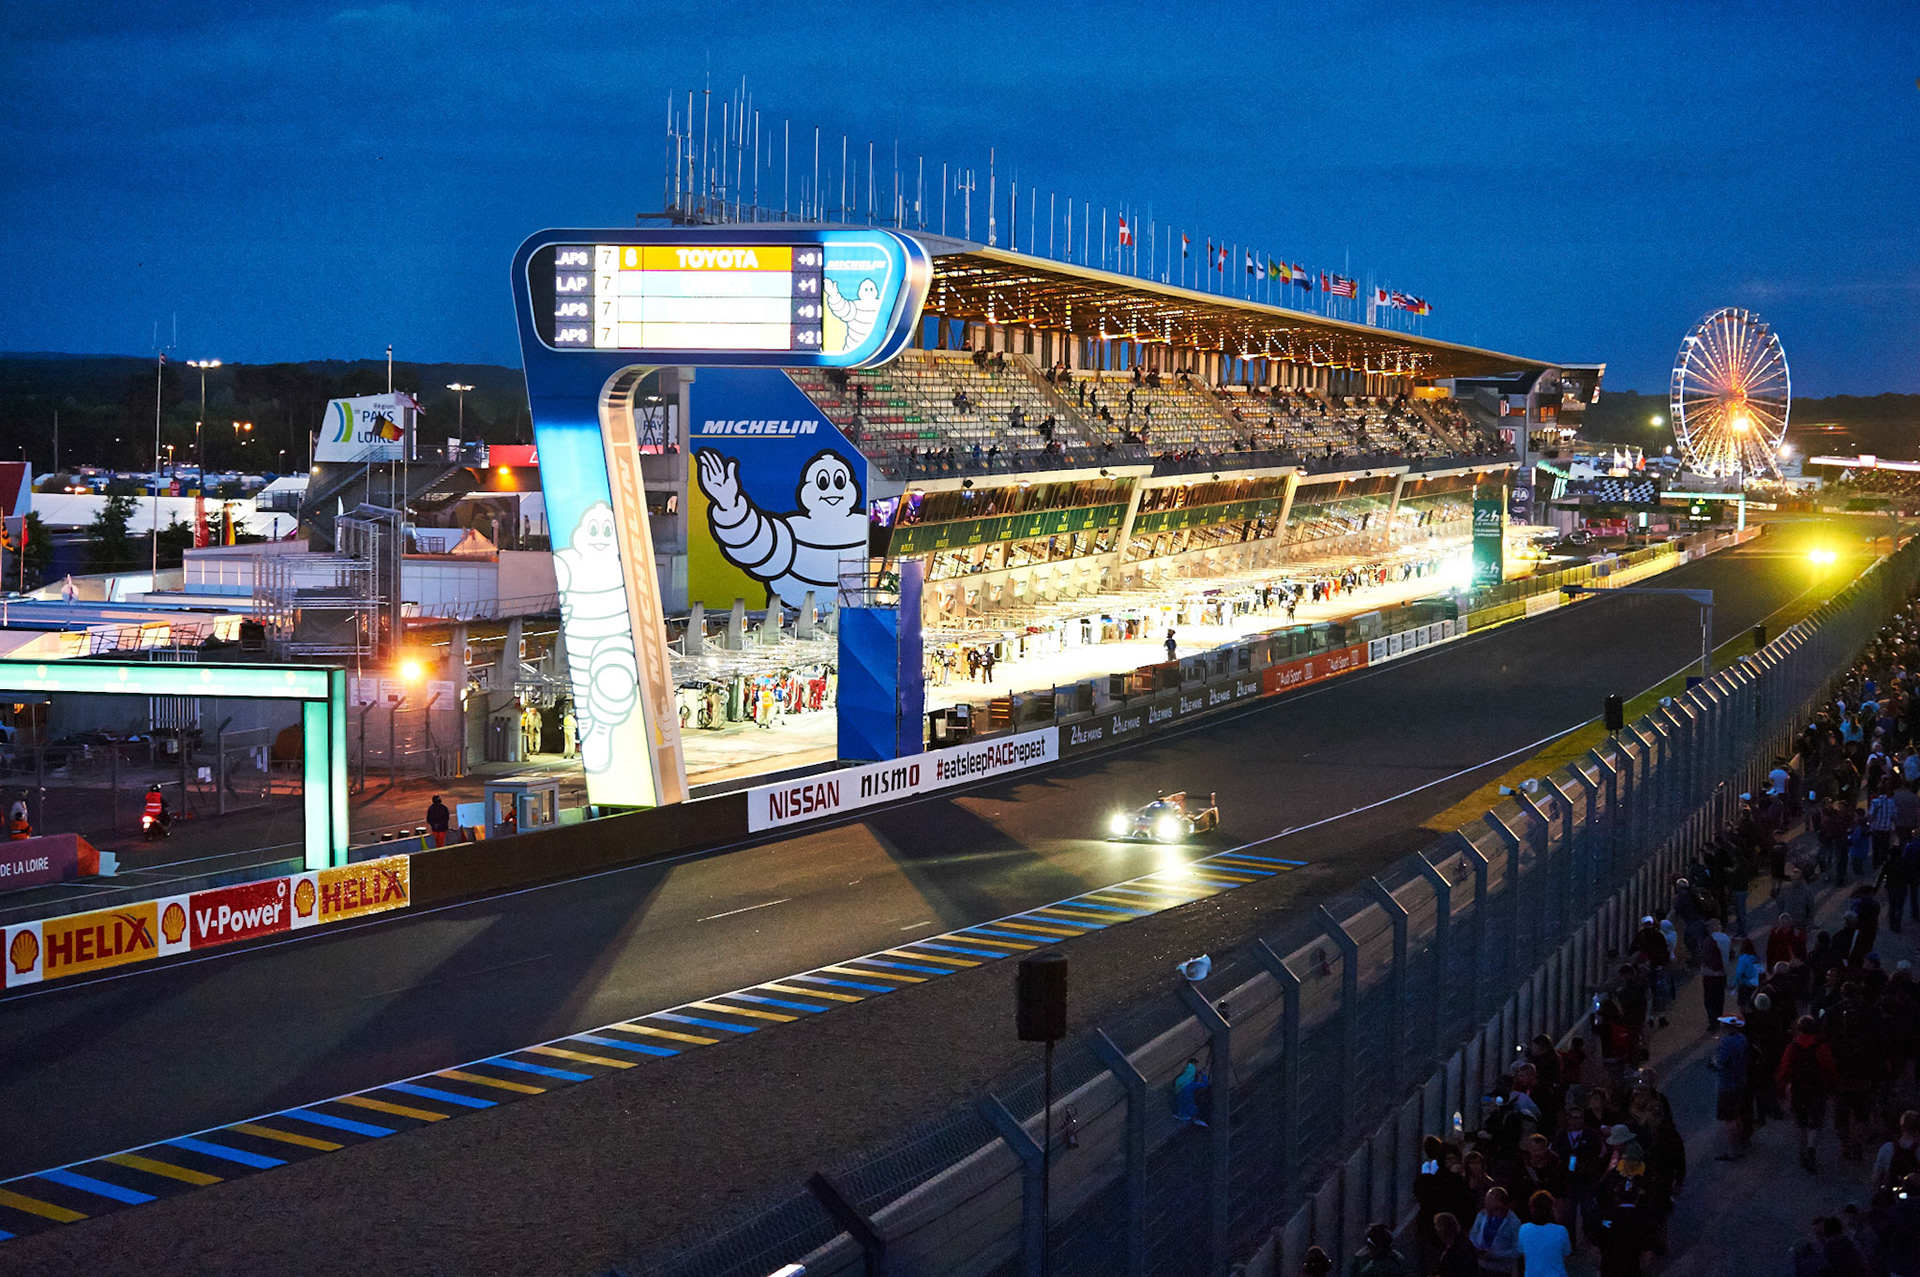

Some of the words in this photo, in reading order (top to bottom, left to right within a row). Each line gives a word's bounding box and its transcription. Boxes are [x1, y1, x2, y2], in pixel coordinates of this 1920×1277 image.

[603, 250, 611, 264] 7
[676, 250, 759, 268] TOYOTA
[826, 260, 887, 269] MICHELIN
[556, 276, 588, 291] LAP
[603, 276, 611, 290] 7
[603, 301, 611, 316] 7
[602, 327, 611, 342] 7
[702, 420, 819, 434] MICHELIN
[618, 456, 663, 684] MICHELIN
[937, 735, 1046, 781] #eatsleepRACErepeat
[769, 780, 840, 821] NISSAN
[0, 863, 11, 877] DE
[13, 860, 24, 875] LA
[25, 857, 49, 873] LOIRE
[322, 868, 404, 915] HELIX
[196, 902, 283, 938] V-Power
[47, 914, 153, 968] HELIX
